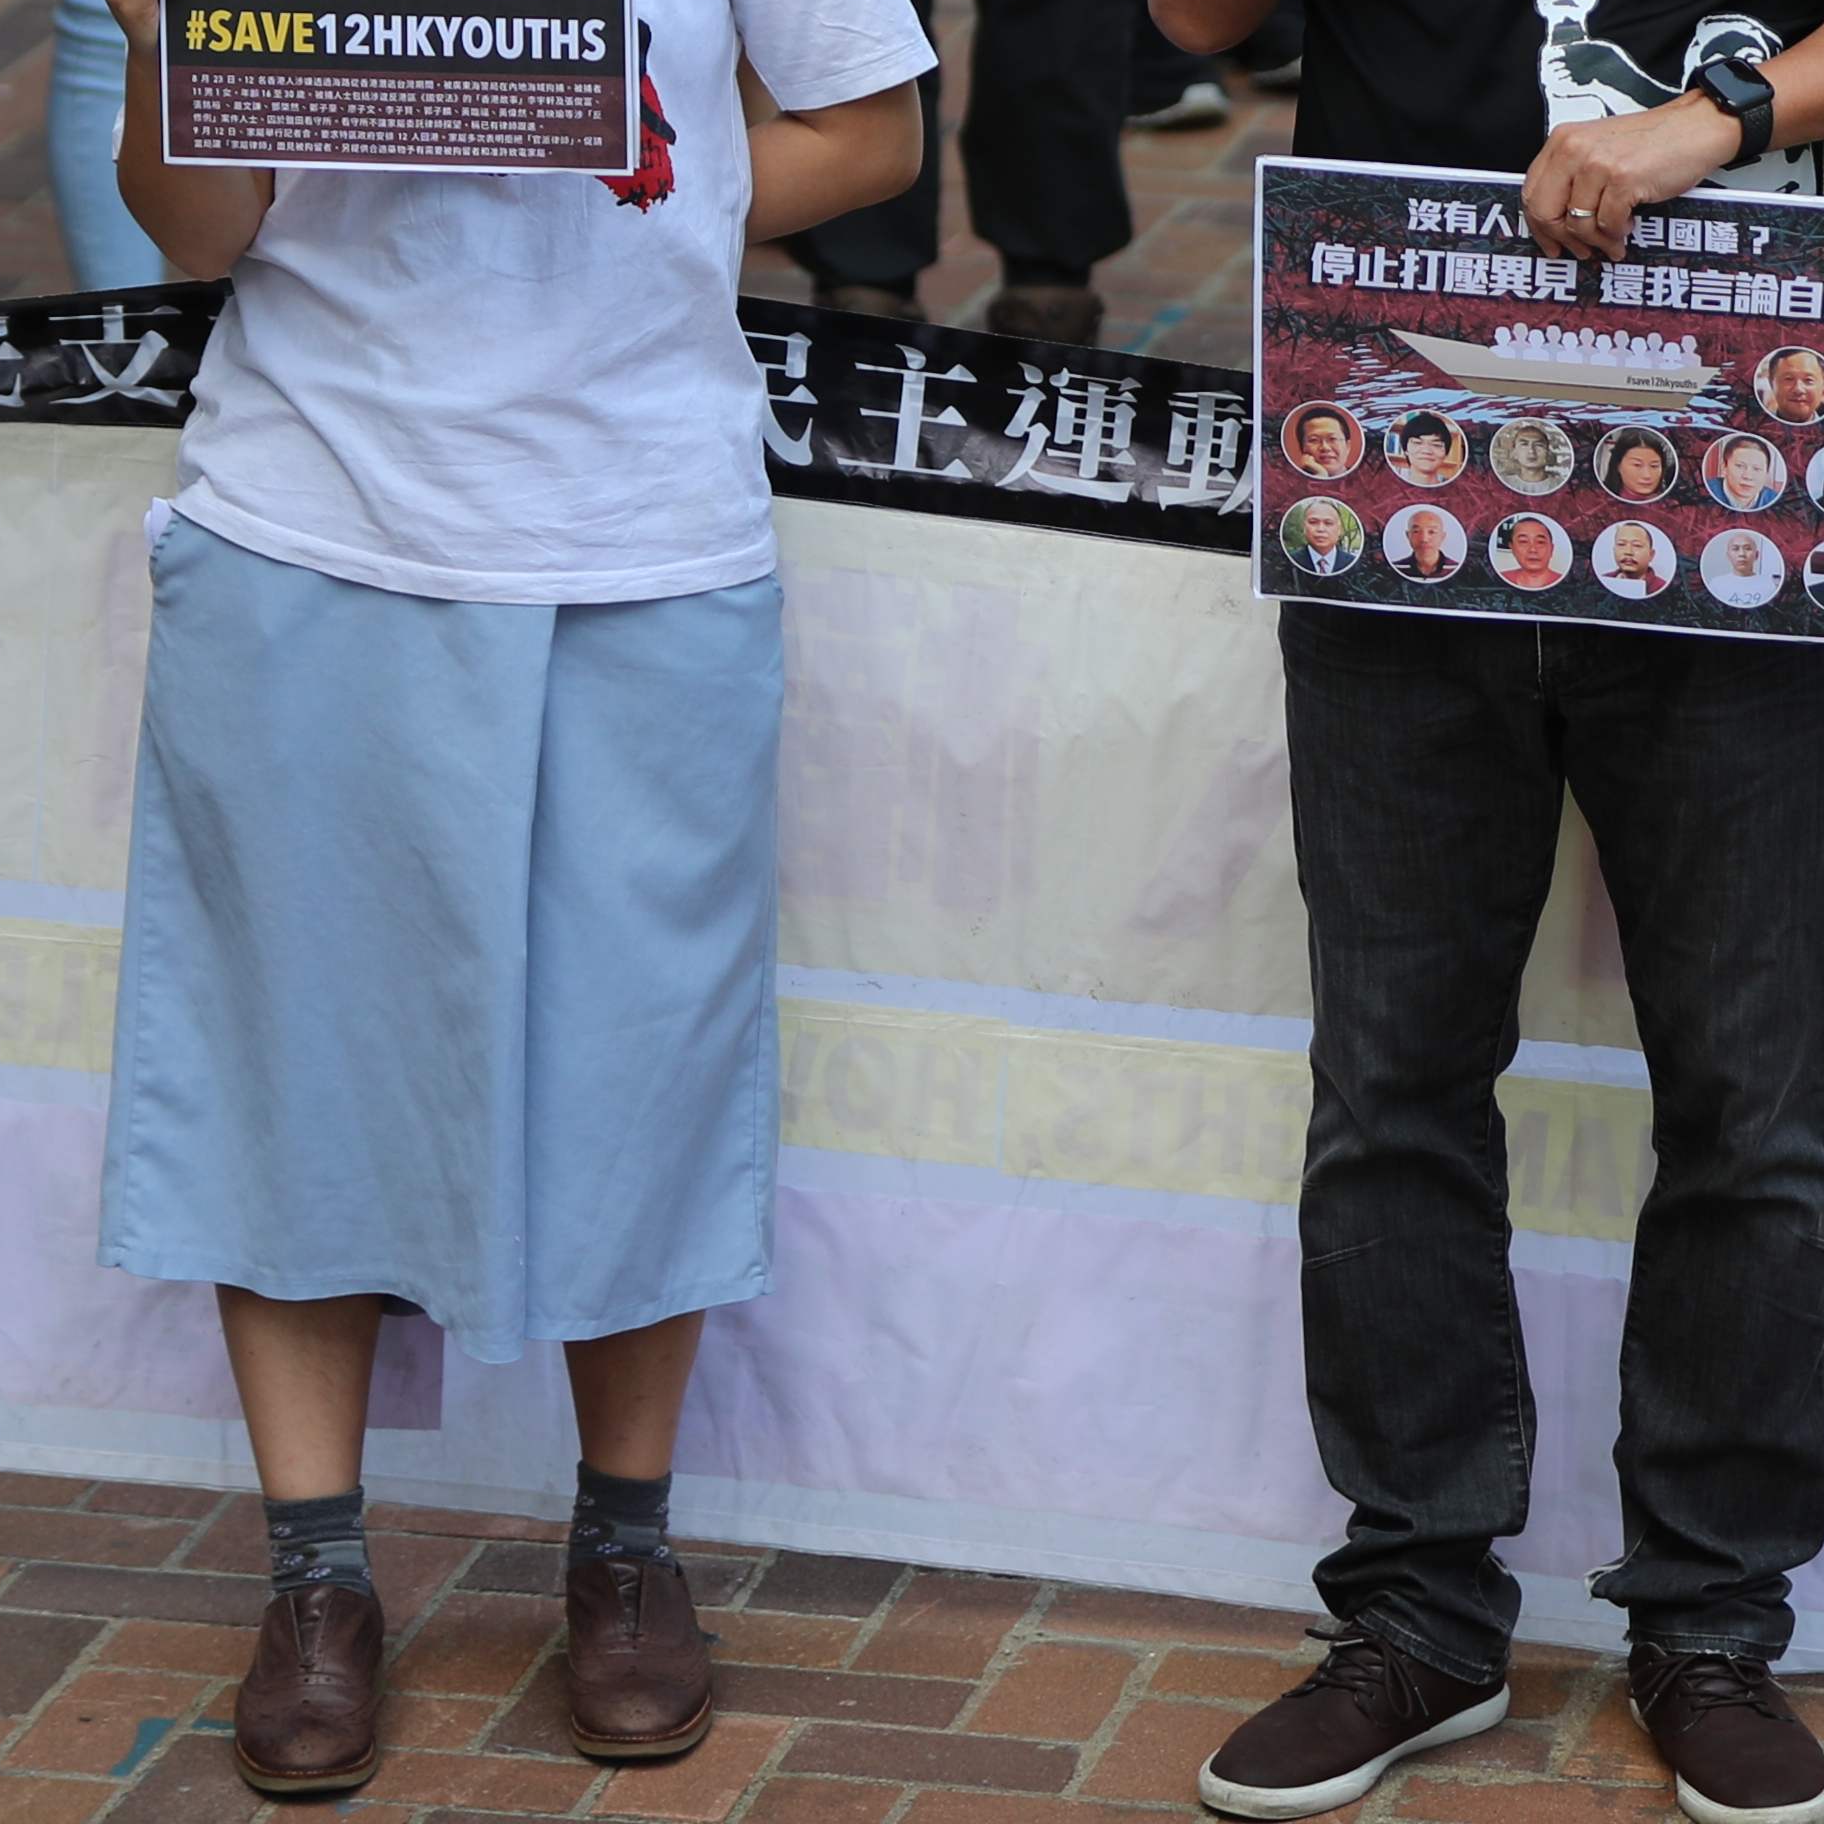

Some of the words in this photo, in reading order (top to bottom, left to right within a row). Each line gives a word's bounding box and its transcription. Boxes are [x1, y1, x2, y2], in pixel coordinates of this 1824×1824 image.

[186, 8, 606, 62] #SAVE12HKYOUTHS
[1408, 197, 1533, 238] 沒有人
[1311, 242, 1577, 302] 停止打壓異見
[1626, 375, 1699, 390] #save12hkyouths
